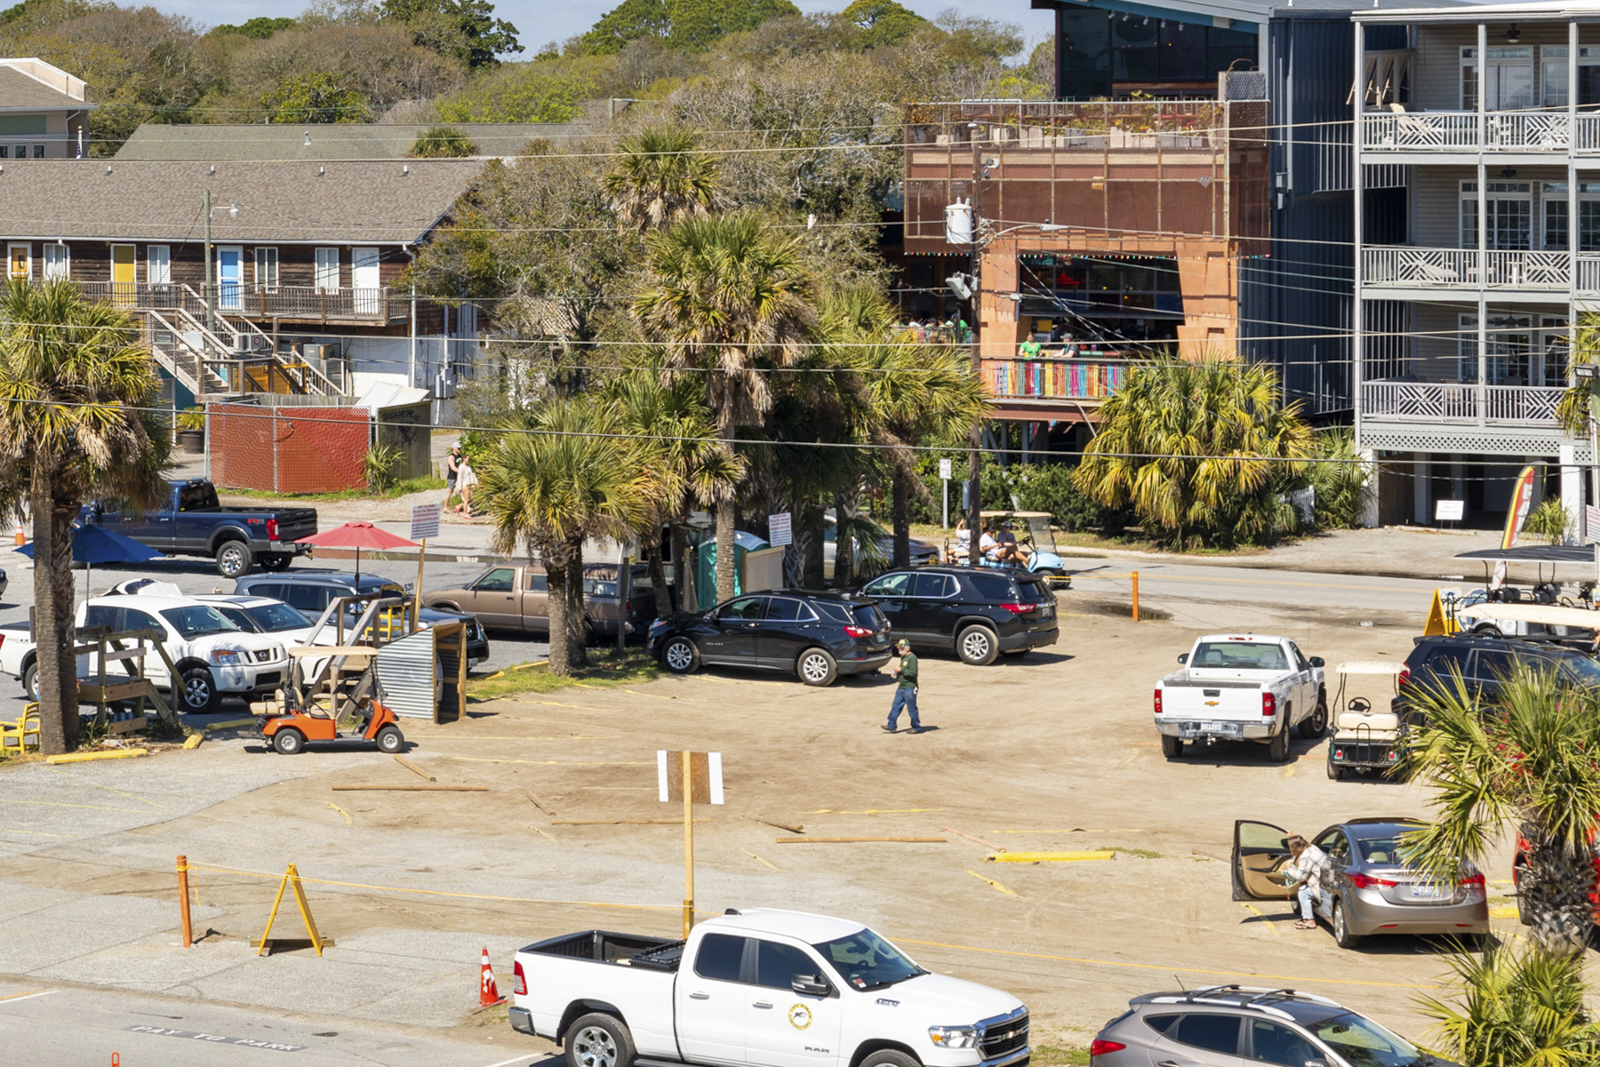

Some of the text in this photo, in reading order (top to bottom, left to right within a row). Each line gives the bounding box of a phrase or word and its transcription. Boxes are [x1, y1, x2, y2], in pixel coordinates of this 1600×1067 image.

[131, 1025, 301, 1051] PAY TO PARK
[804, 1045, 830, 1053] RAM
